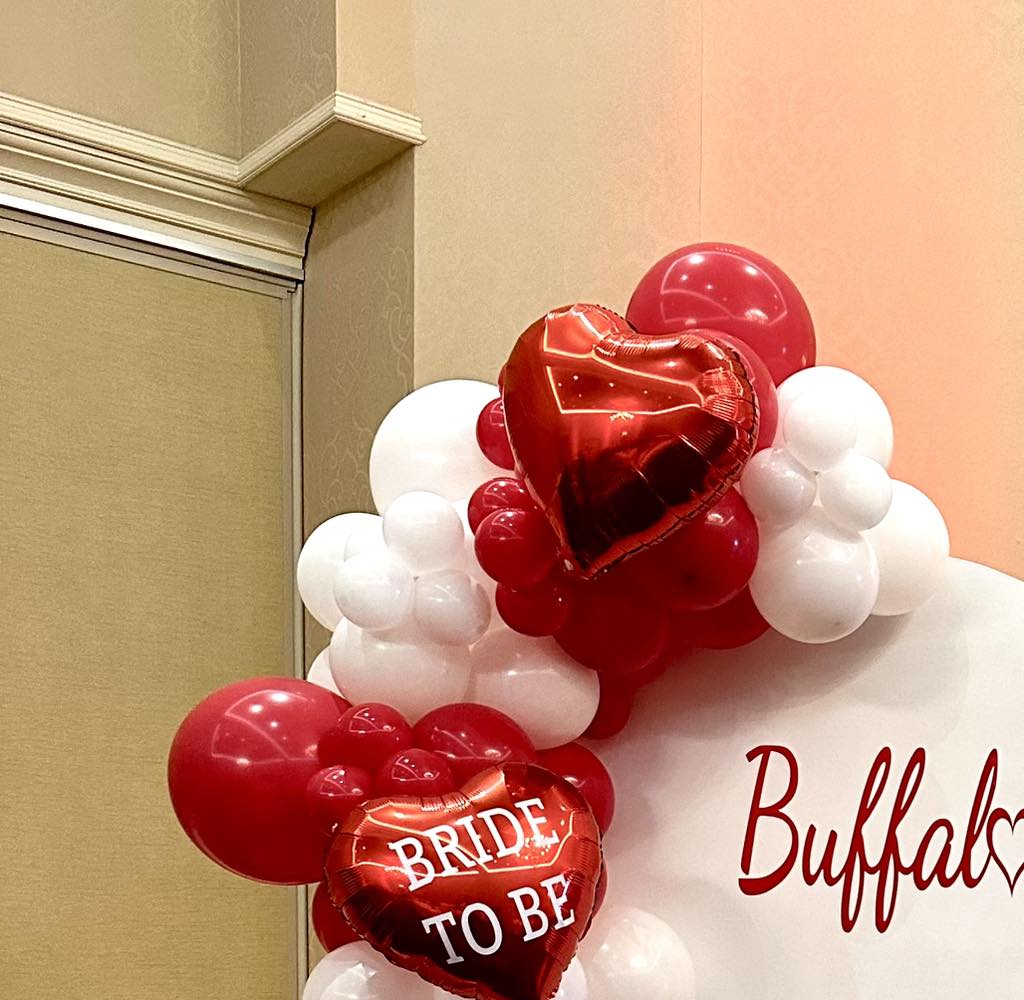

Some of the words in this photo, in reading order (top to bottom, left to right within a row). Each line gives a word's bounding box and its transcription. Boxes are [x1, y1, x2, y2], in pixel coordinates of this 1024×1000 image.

[388, 798, 560, 892] BRIDE
[421, 902, 503, 965] TO
[507, 873, 576, 942] BE
